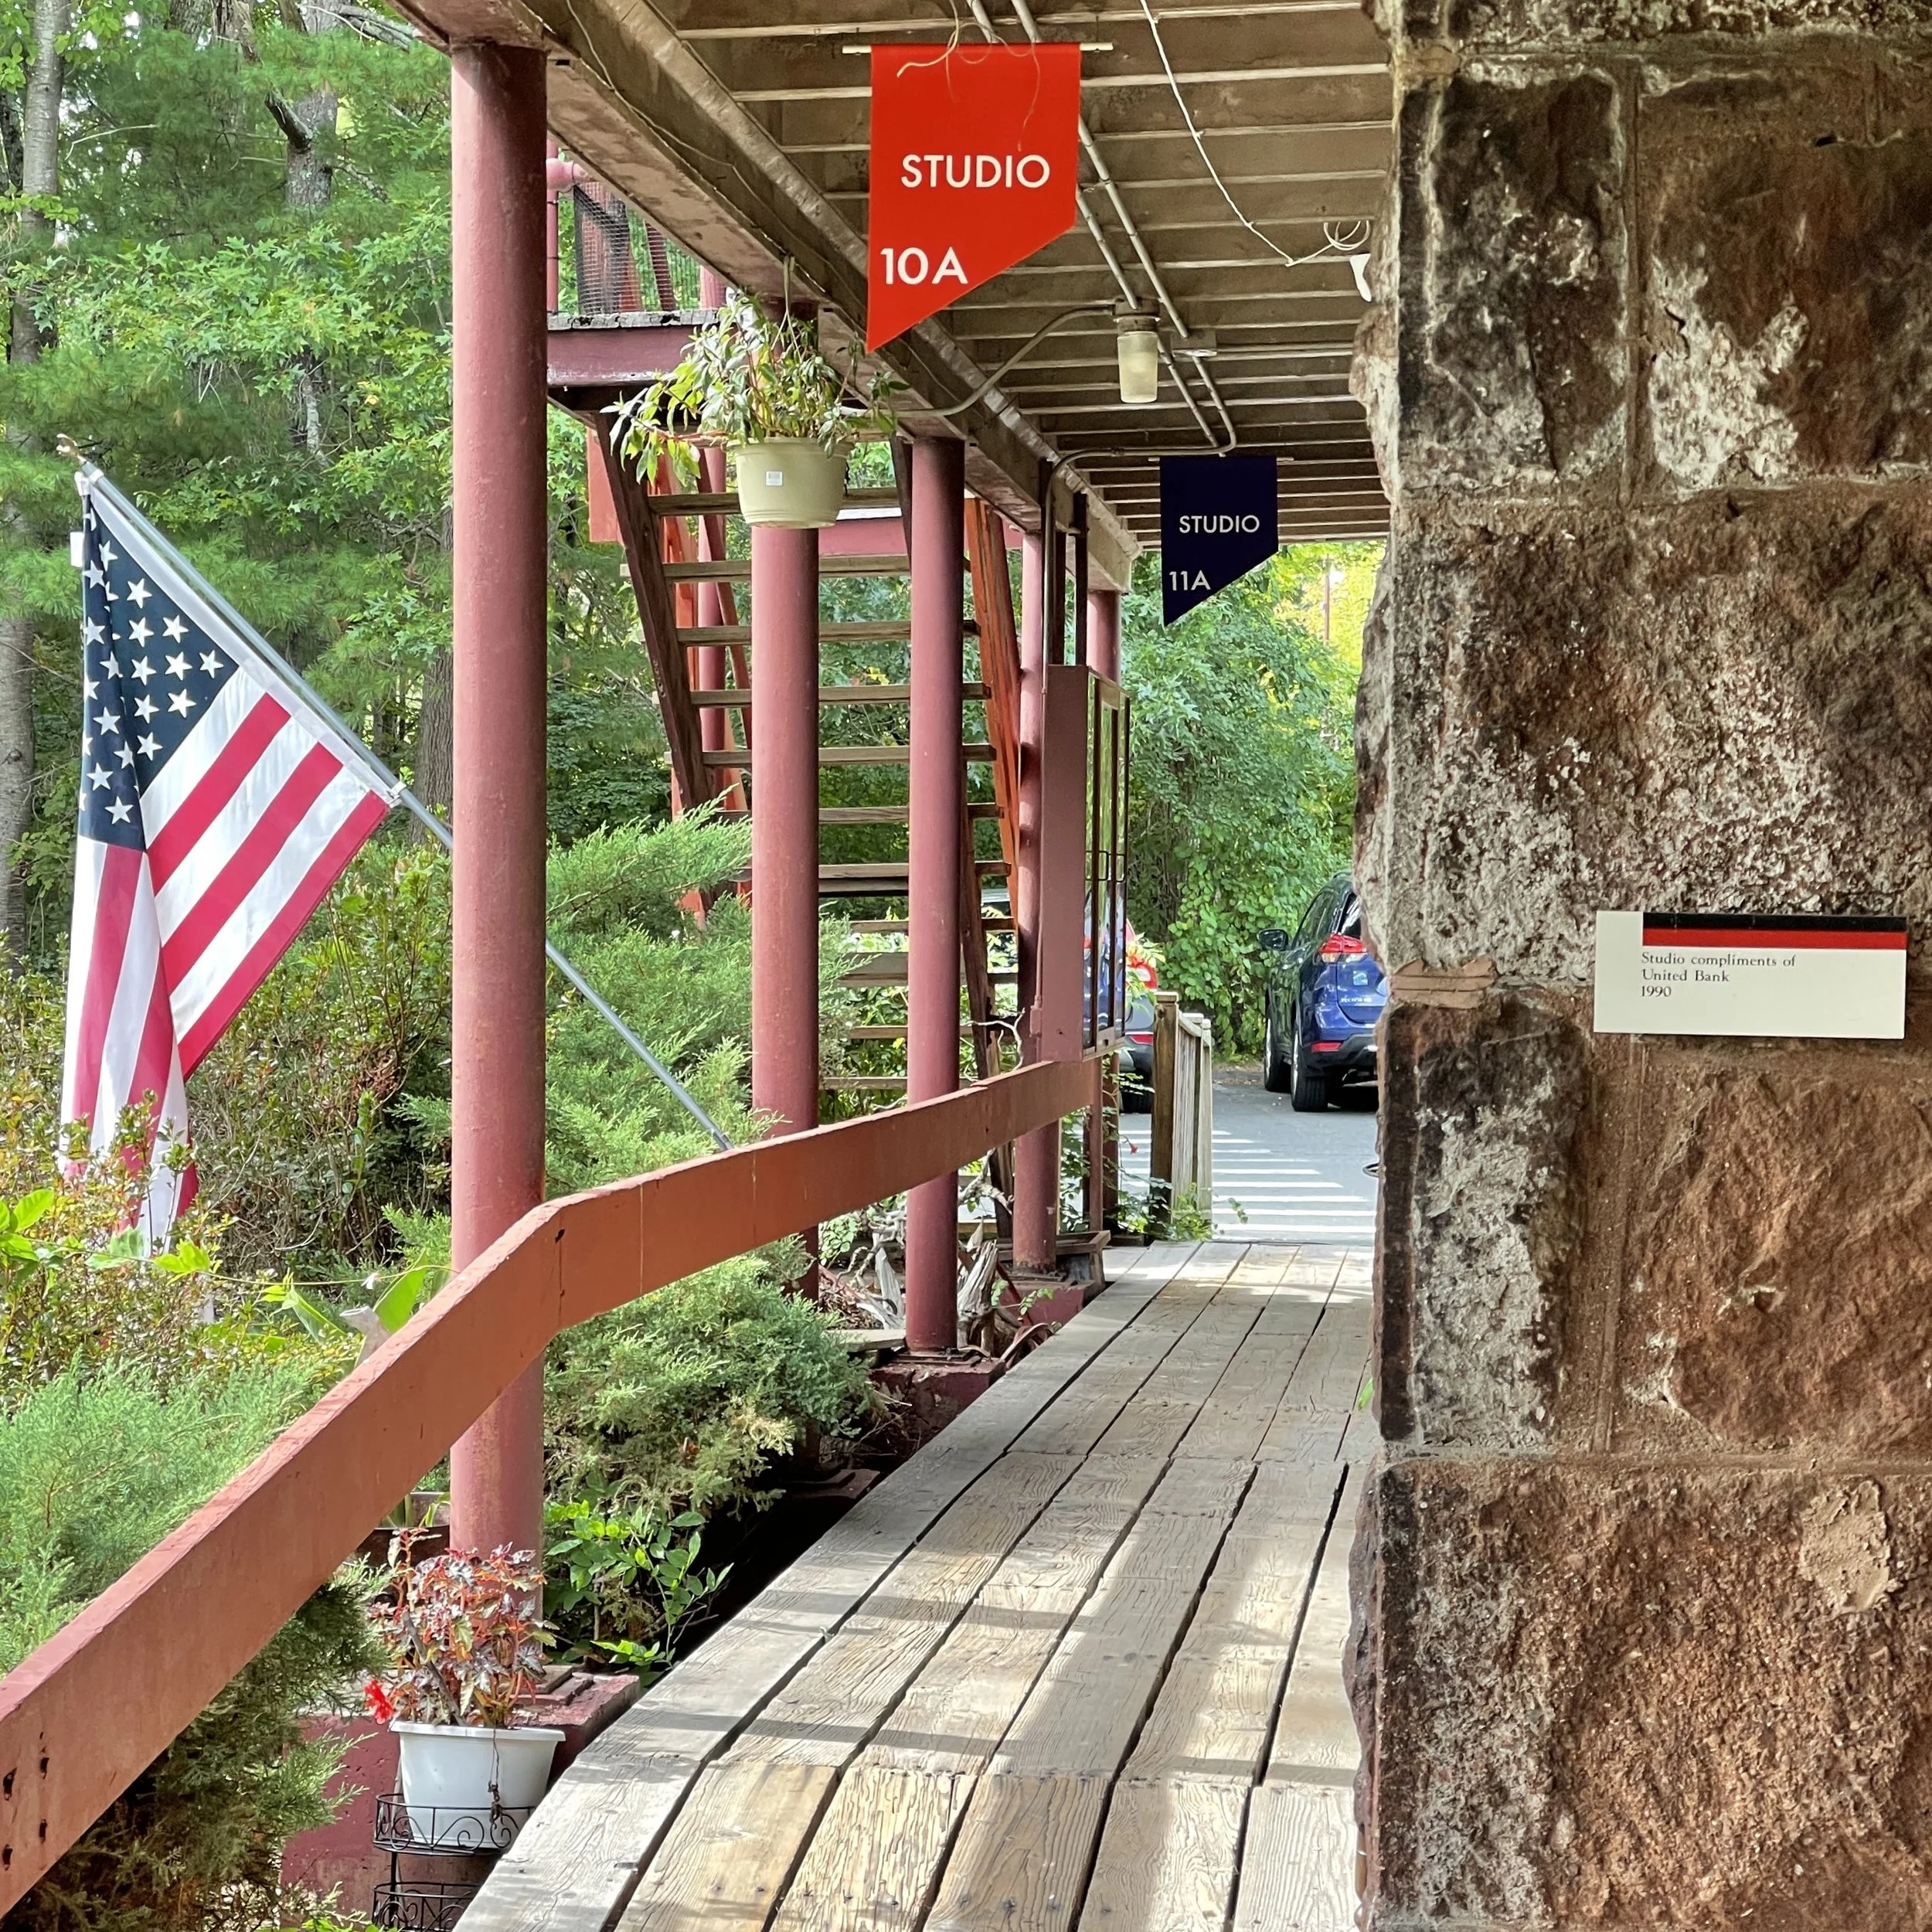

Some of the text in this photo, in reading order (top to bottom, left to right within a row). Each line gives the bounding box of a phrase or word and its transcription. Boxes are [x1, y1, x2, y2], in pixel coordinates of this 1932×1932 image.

[900, 154, 1050, 189] STUDIO
[1179, 514, 1260, 534] STUDIO
[1168, 570, 1211, 591] 11A
[1641, 951, 1796, 968] Studio compliments of
[1641, 968, 1730, 982] United Bank
[1641, 985, 1672, 998] 1990
